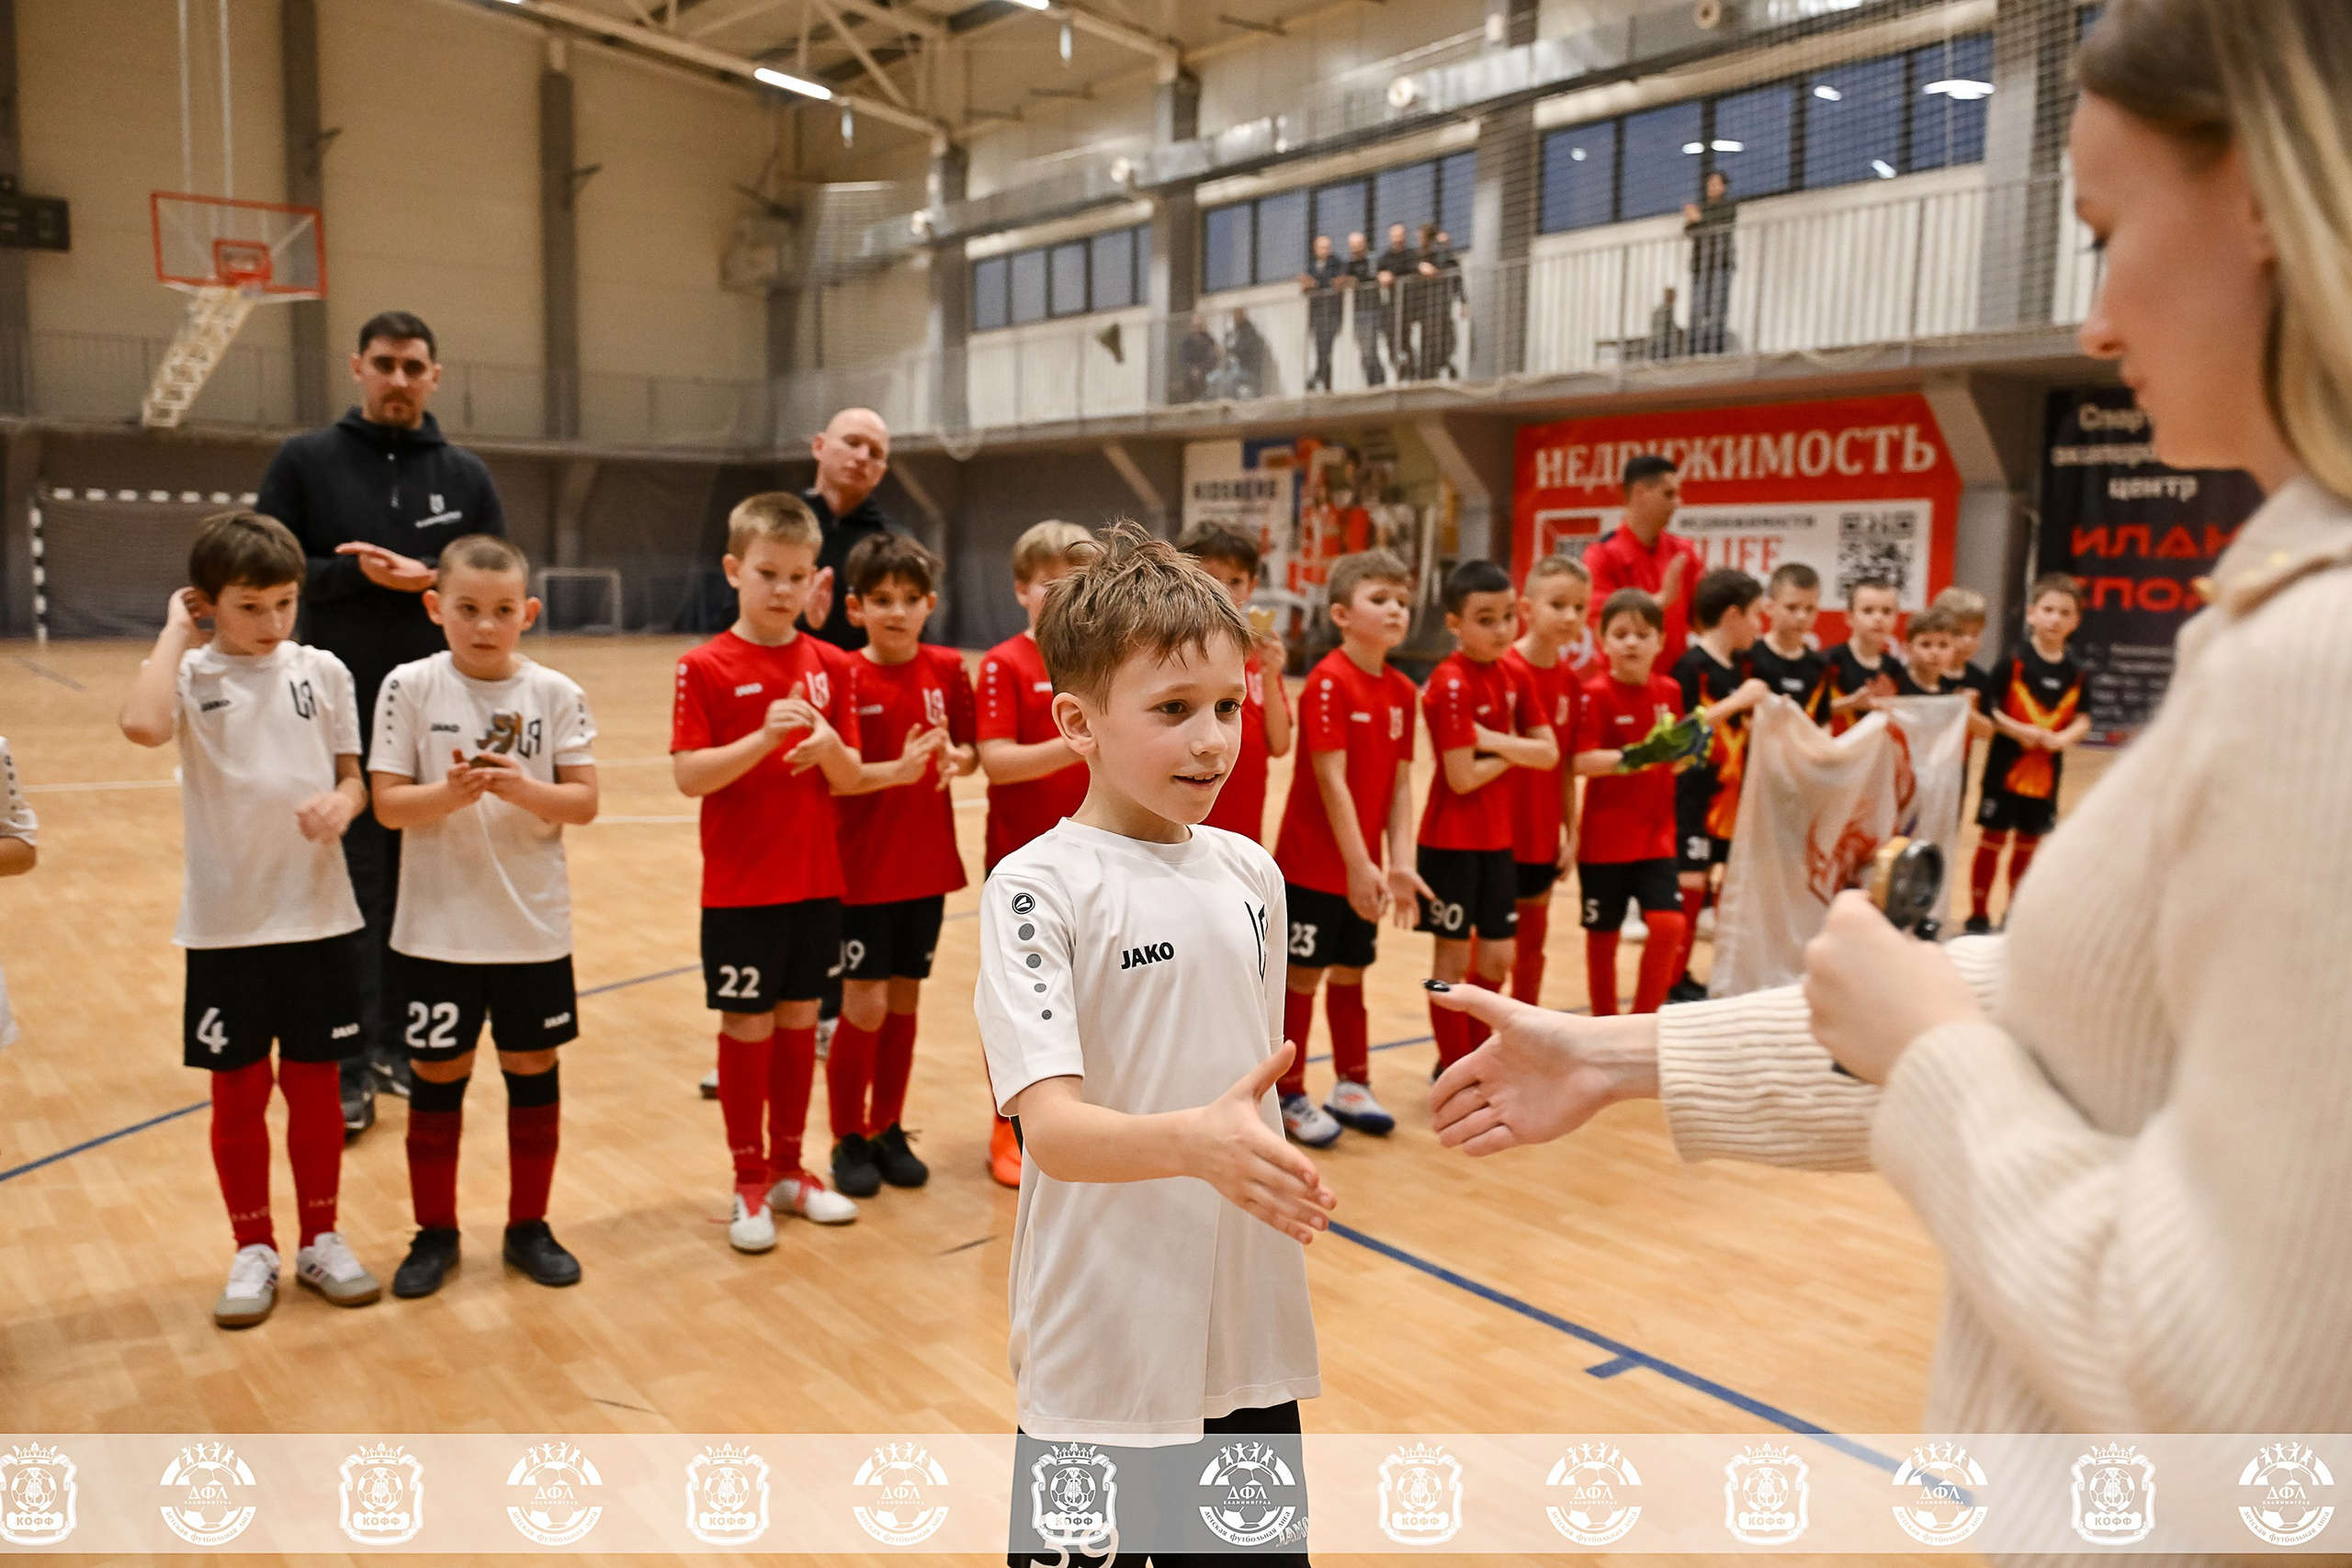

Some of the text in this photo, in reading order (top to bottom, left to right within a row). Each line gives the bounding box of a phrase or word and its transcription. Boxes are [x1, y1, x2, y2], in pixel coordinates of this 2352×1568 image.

[1121, 942, 1174, 970] JAKO
[1288, 921, 1318, 958] 23
[717, 964, 761, 999] 22
[196, 1006, 230, 1055] 4
[404, 1000, 459, 1049] 22
